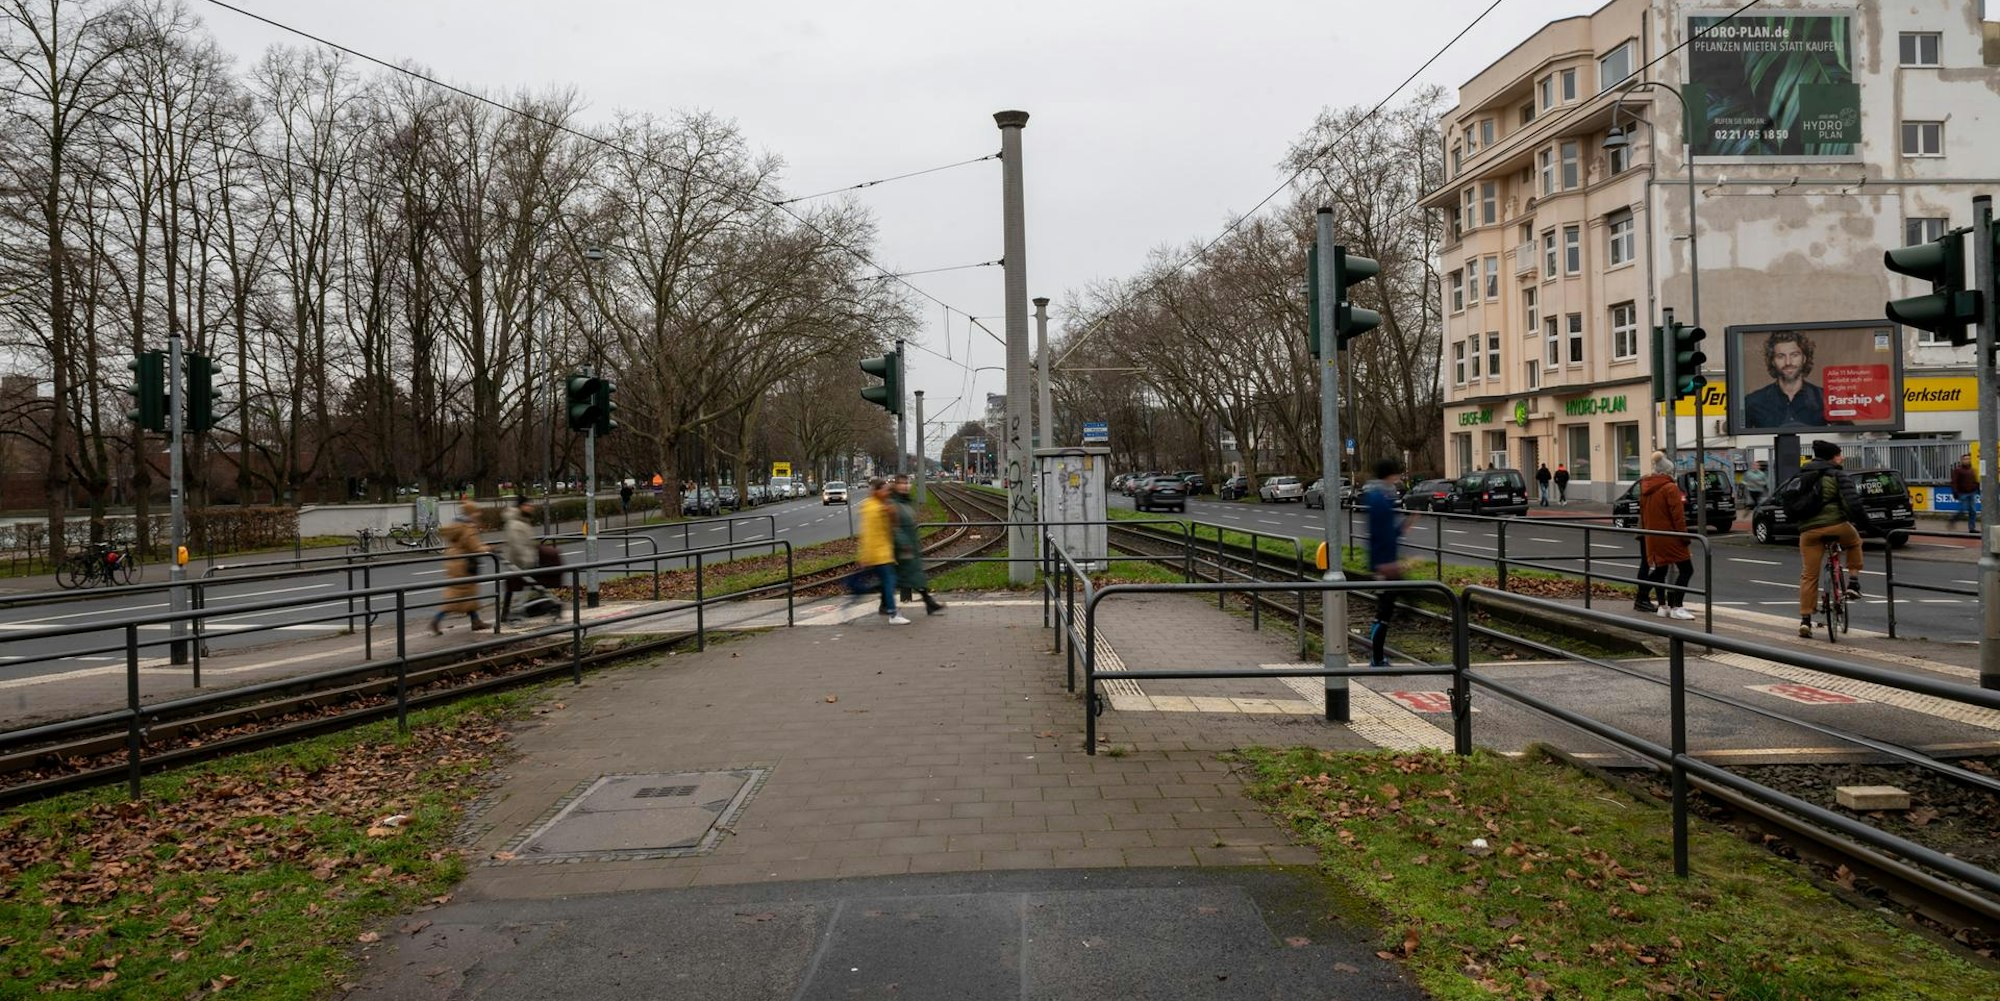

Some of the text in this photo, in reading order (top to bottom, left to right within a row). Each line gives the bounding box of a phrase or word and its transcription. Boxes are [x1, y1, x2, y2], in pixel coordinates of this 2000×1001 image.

[1694, 26, 1790, 38] HYDRO-PLAN.de
[1694, 41, 1741, 52] PFLANZEN
[1743, 41, 1777, 52] MIETEN
[1779, 41, 1803, 52] STATT
[1803, 121, 1843, 131] HYDRO
[1818, 131, 1843, 139] PLAN
[1565, 394, 1628, 416] HYDRO-PLAN
[1828, 393, 1873, 407] Parship
[1855, 481, 1882, 491] HYDRO
[1867, 487, 1884, 495] PLAN
